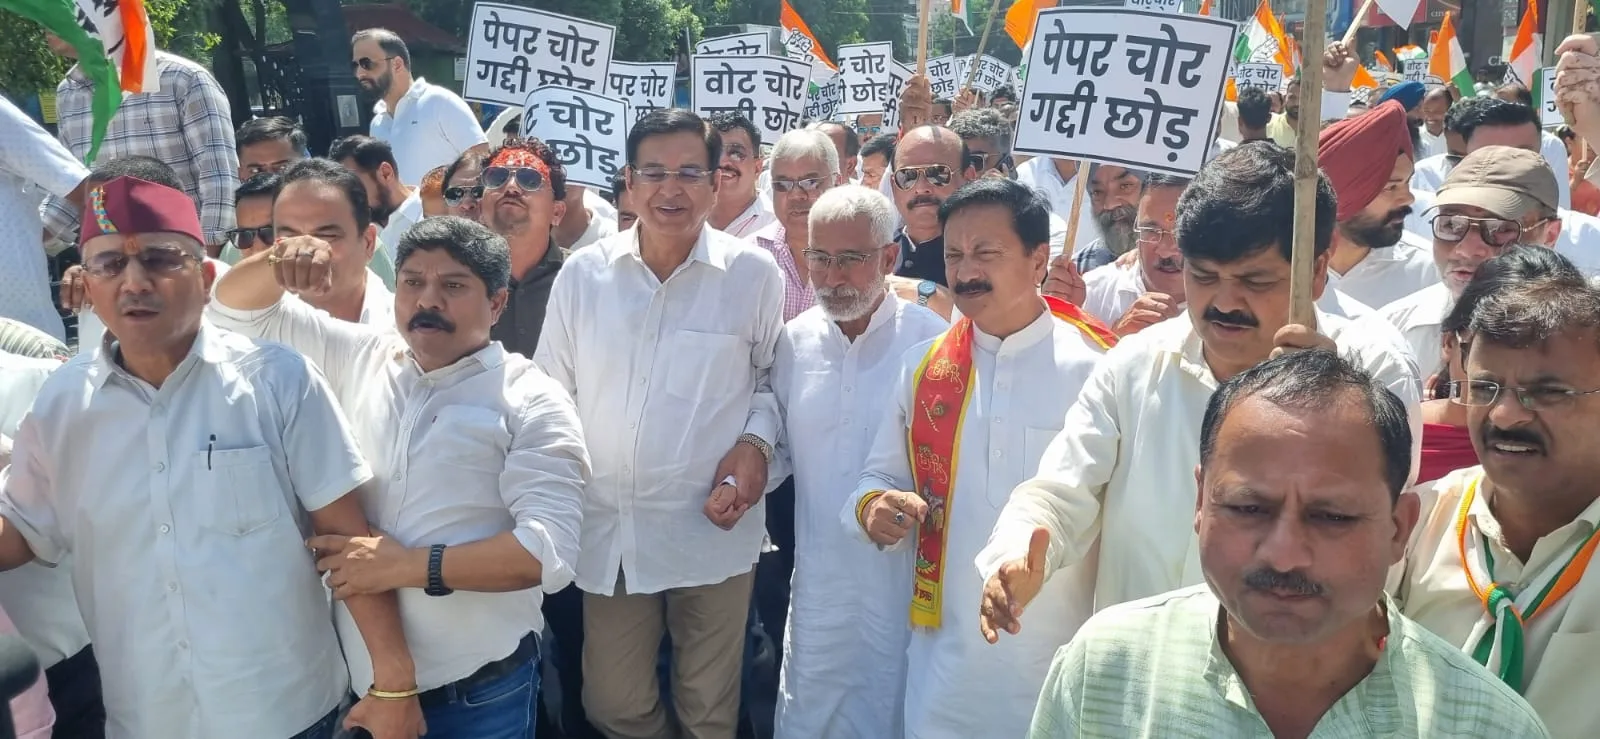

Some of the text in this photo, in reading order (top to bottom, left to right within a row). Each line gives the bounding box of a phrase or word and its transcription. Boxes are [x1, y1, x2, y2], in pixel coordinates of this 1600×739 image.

[483, 11, 600, 67] पेपर चोर
[1043, 19, 1211, 88] पेपर चोर
[477, 55, 531, 94] गद्दी
[850, 49, 885, 74] चोर
[929, 60, 950, 78] चोर
[1256, 66, 1278, 80] चोर
[641, 68, 669, 97] चोर
[703, 62, 757, 95] वोट
[763, 65, 805, 100] चोर
[547, 95, 615, 136] चोर
[1030, 80, 1199, 162] गद्दी छोड़
